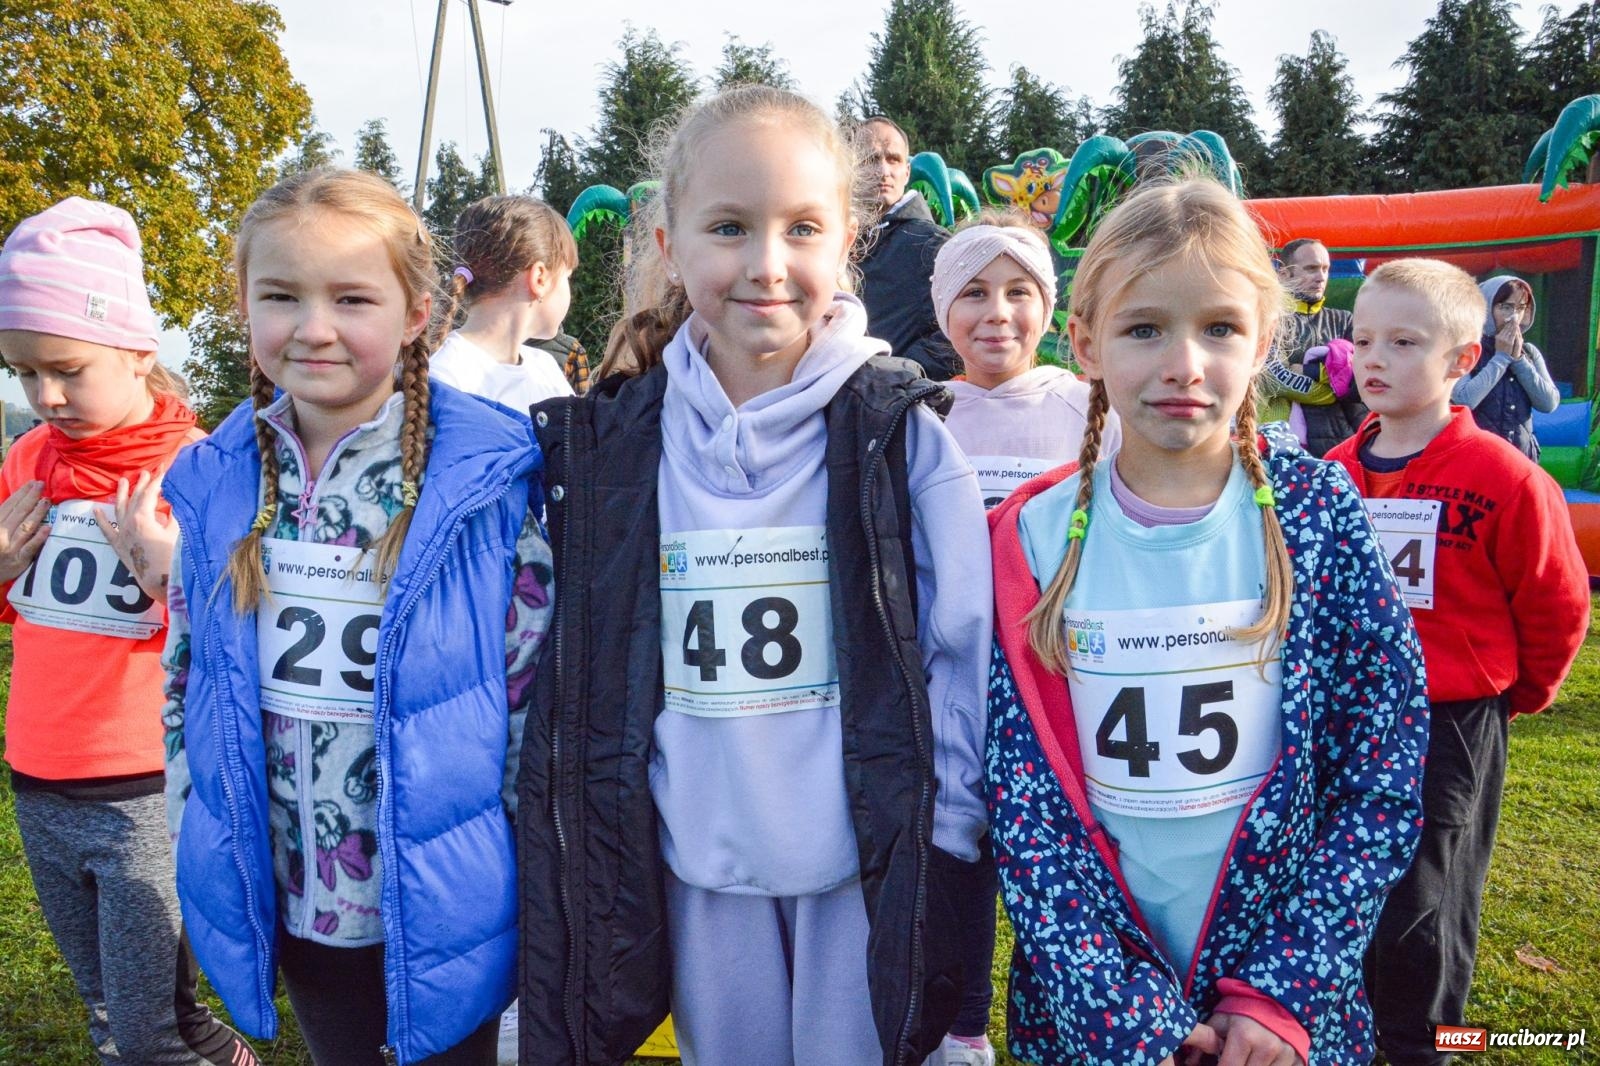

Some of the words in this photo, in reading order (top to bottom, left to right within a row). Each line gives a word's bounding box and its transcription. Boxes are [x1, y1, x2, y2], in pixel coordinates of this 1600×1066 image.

[1463, 490, 1497, 511] MAN
[23, 543, 155, 614] 105
[1390, 539, 1425, 587] 4
[272, 606, 381, 692] 29
[683, 597, 803, 681] 48
[1096, 681, 1238, 778] 45
